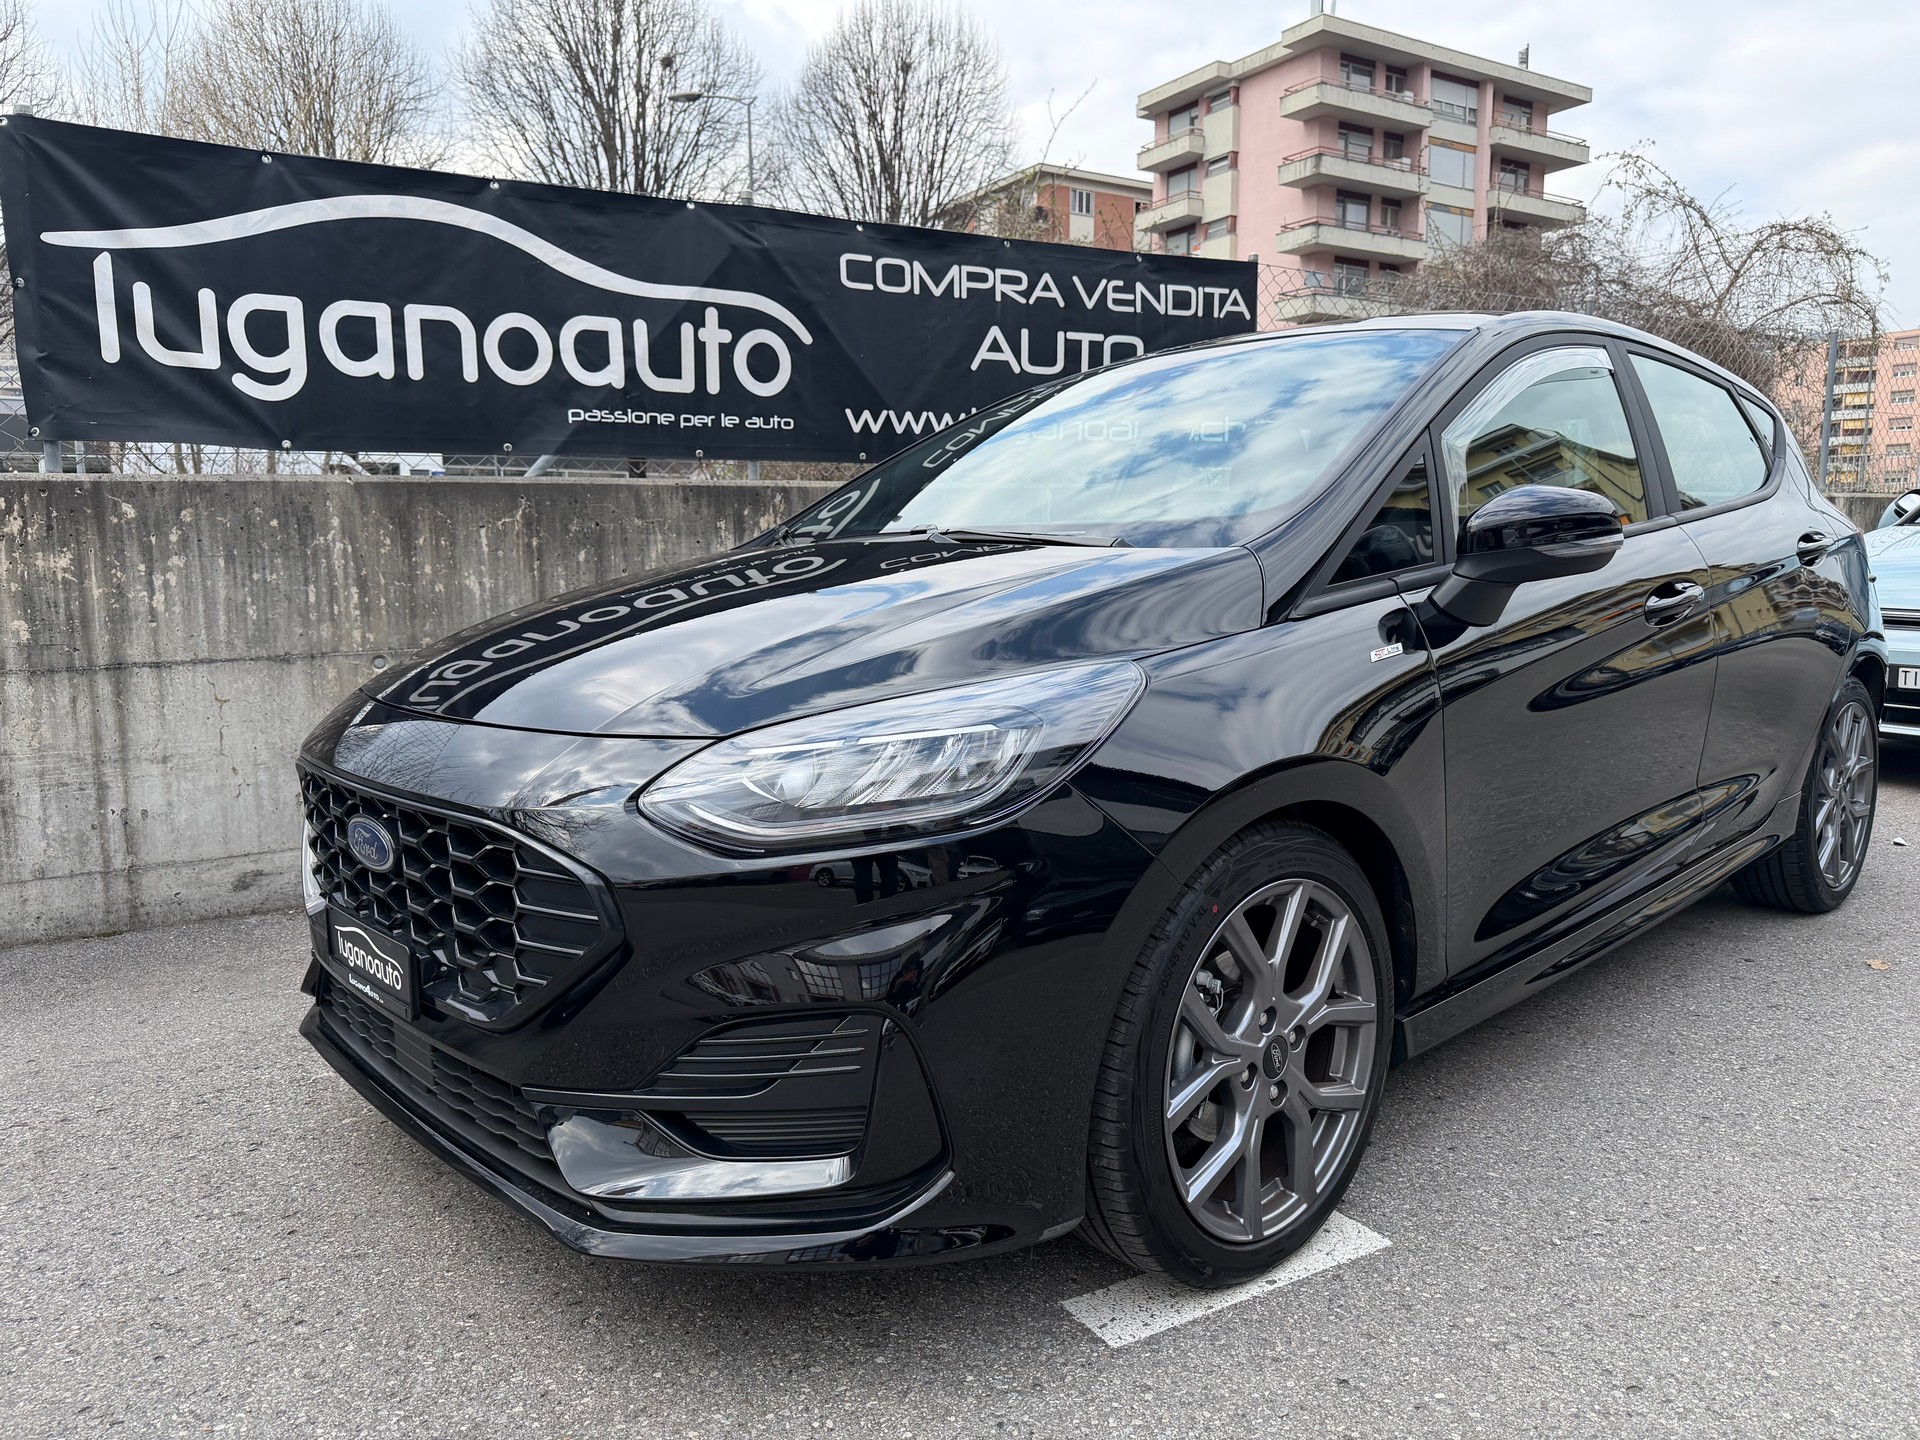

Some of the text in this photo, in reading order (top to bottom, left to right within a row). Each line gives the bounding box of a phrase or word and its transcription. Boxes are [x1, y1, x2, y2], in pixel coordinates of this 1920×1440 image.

[839, 252, 1252, 321] COMPRA VENDITA
[93, 250, 792, 402] luganoauto
[970, 325, 1145, 375] AUTO
[567, 408, 795, 430] passione per le auto
[1901, 669, 1918, 687] TI
[353, 827, 379, 861] Ford
[337, 930, 403, 992] luganoauto
